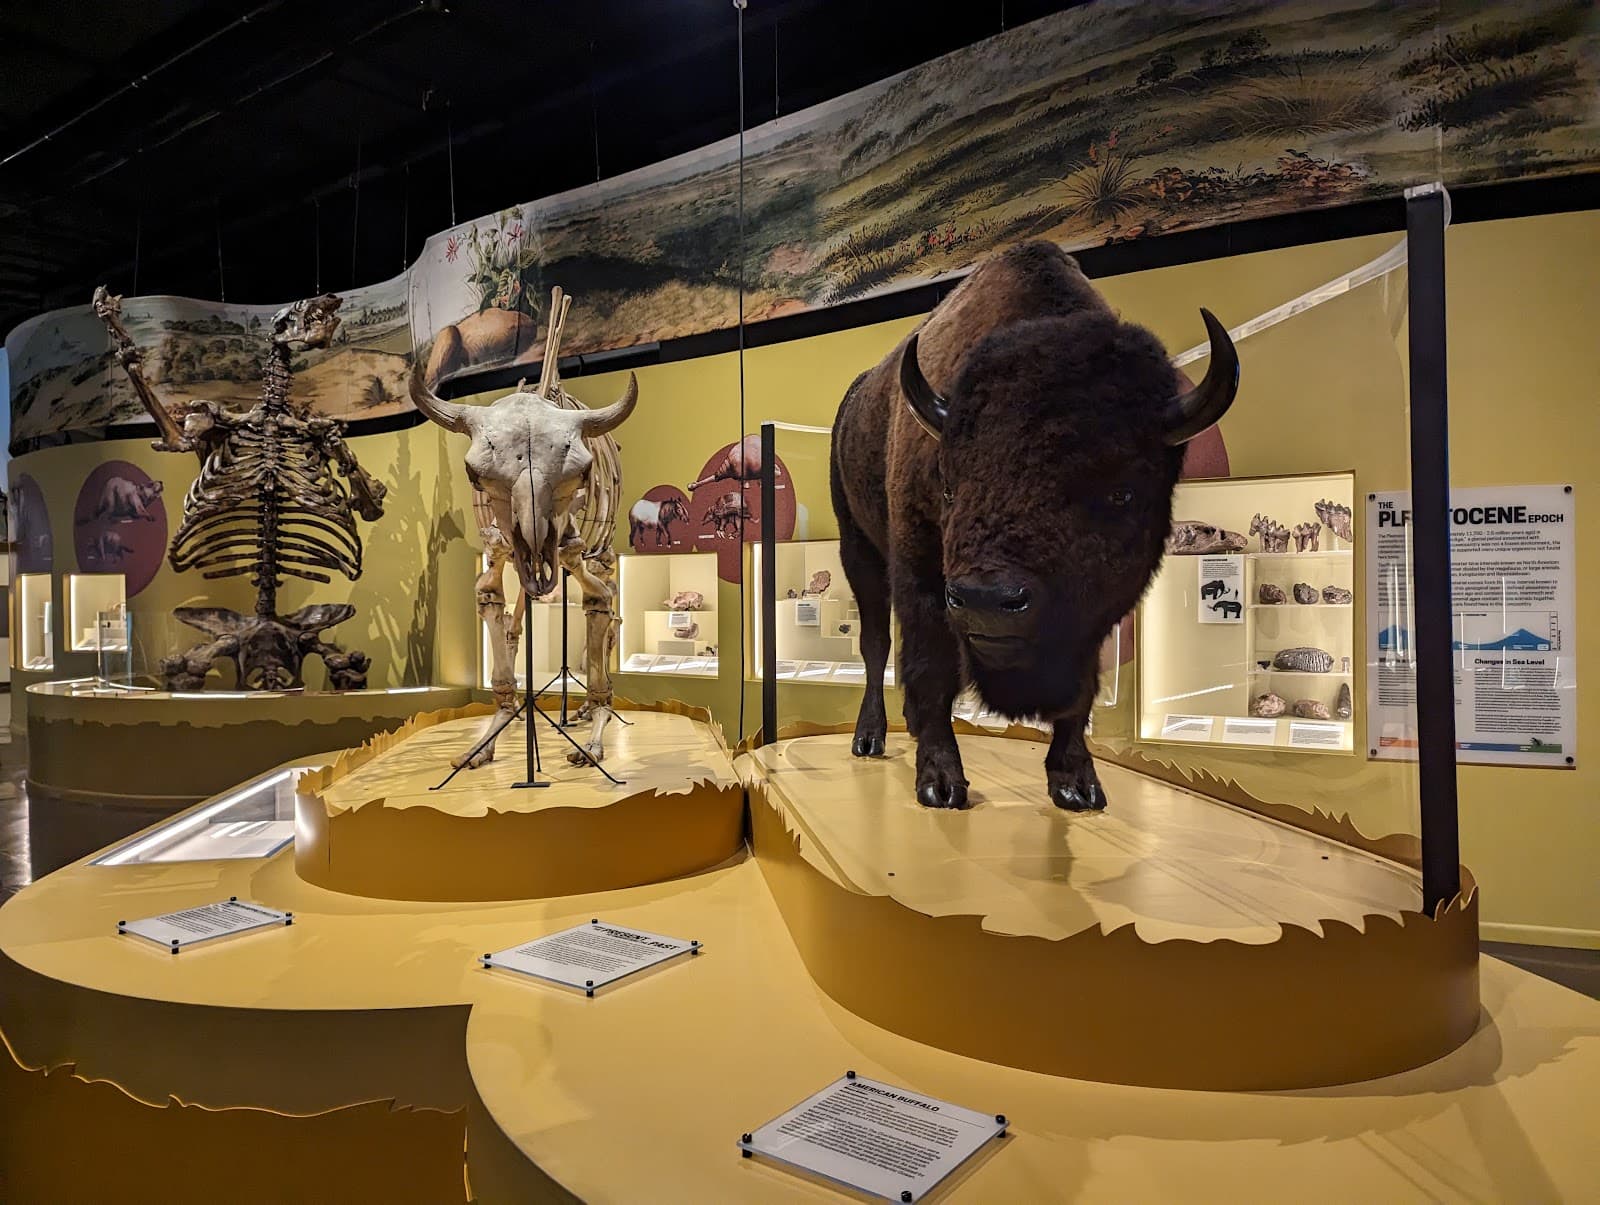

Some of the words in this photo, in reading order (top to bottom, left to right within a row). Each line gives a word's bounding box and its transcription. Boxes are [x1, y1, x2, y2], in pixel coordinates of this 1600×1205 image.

[1379, 506, 1527, 527] PLEOCENE
[1528, 514, 1564, 523] EPOCH
[1474, 658, 1503, 666] Changes
[849, 1082, 898, 1099] AMERICAN
[897, 1096, 940, 1112] BUFFALO
